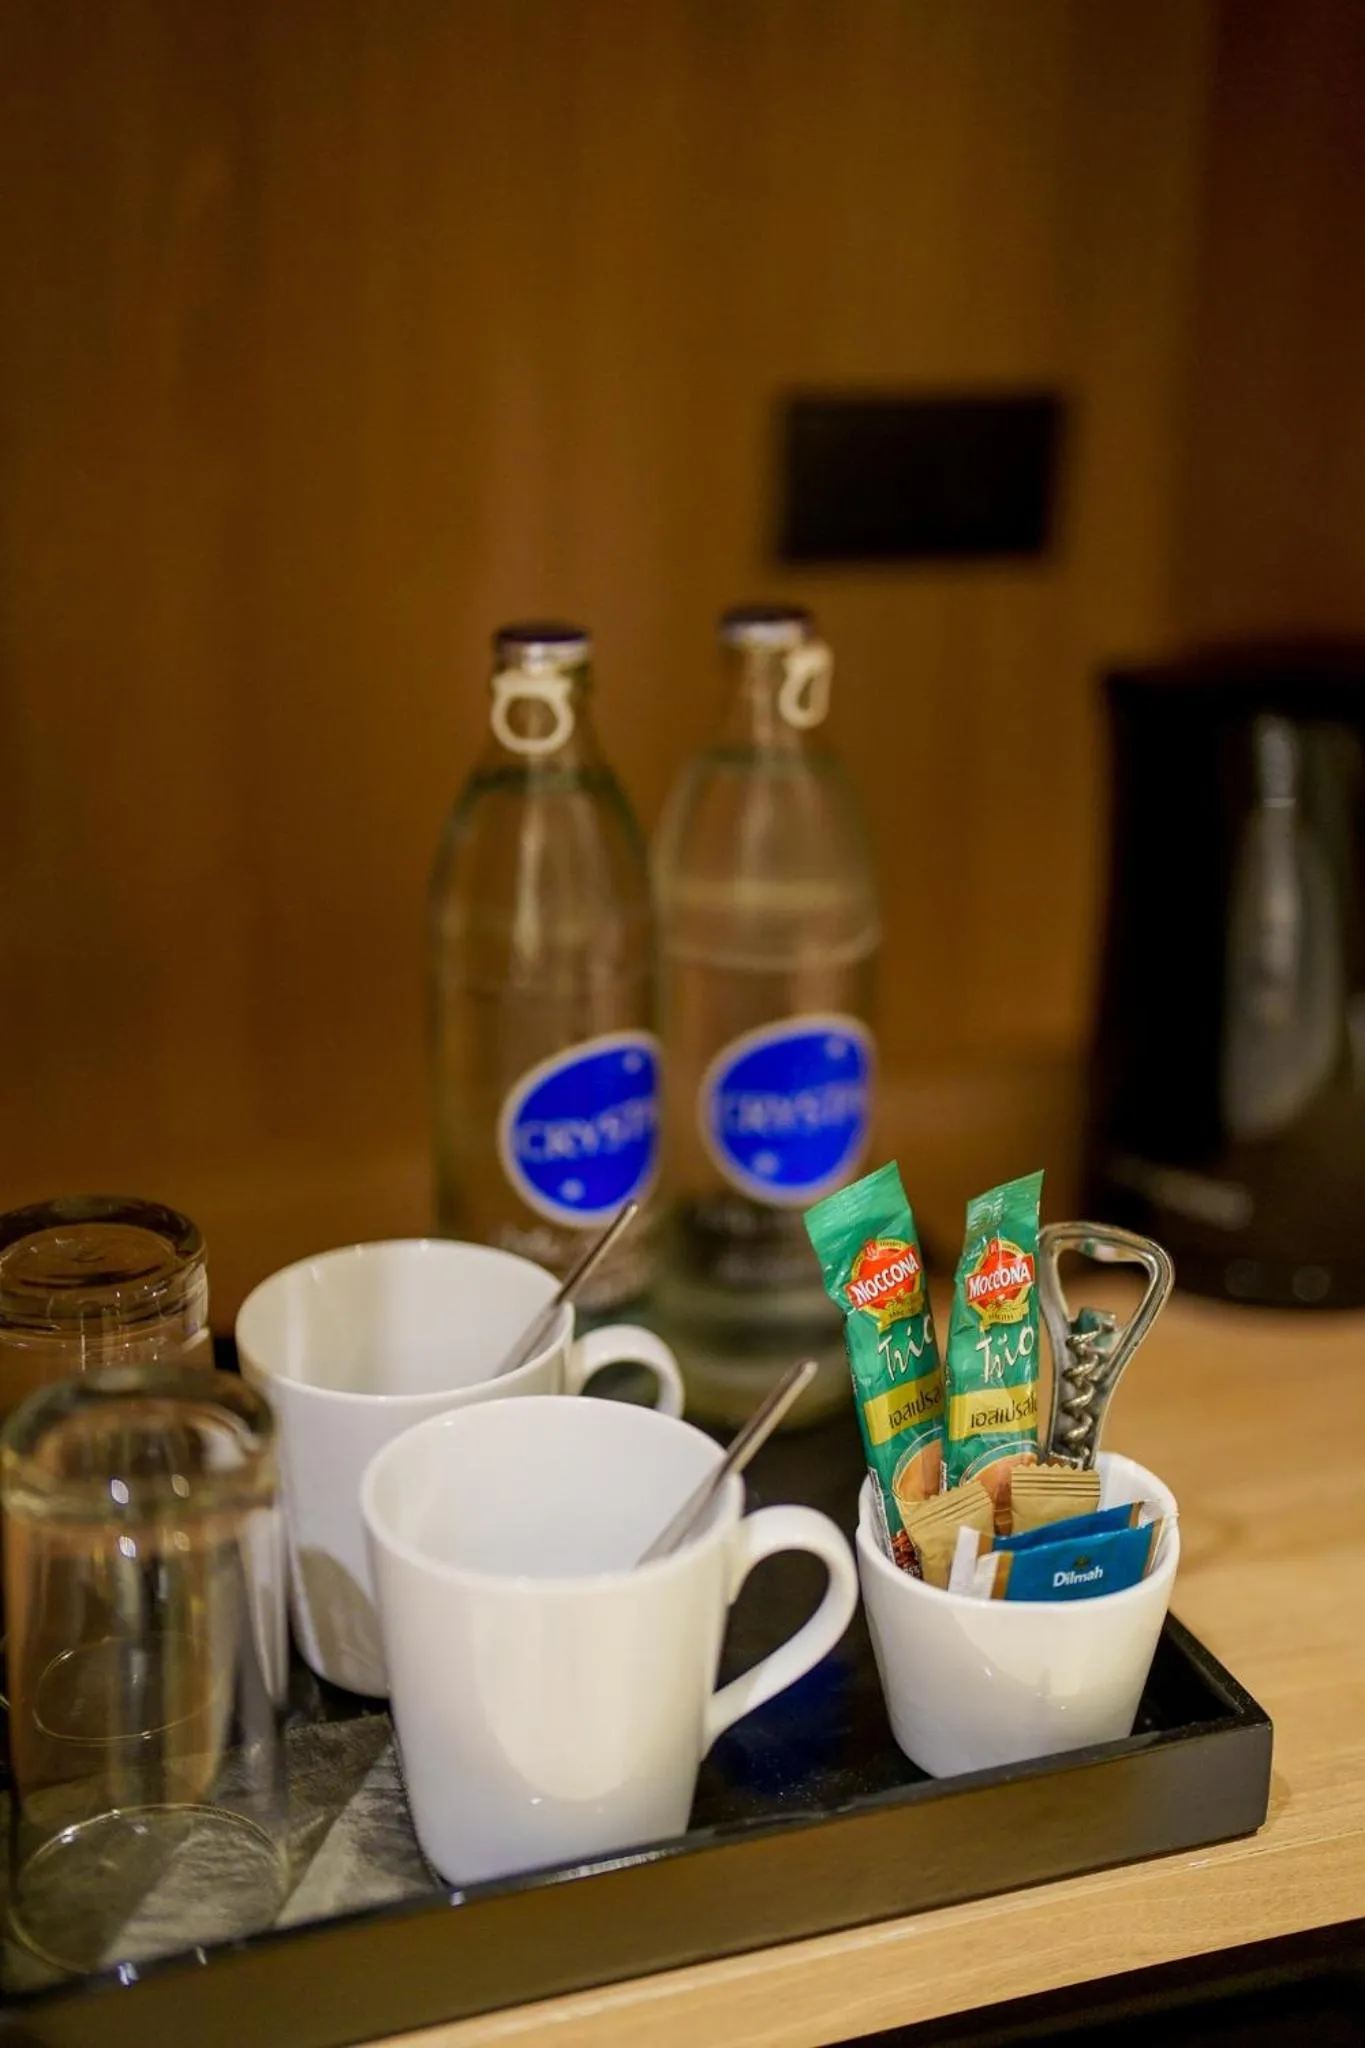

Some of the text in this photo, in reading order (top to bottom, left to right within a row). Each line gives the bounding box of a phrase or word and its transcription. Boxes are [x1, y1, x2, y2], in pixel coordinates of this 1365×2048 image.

[850, 1252, 920, 1306] MOCCONA
[968, 1261, 1032, 1300] MOCCONA
[976, 1326, 1034, 1384] Trio
[1053, 1565, 1104, 1587] Dilmah
